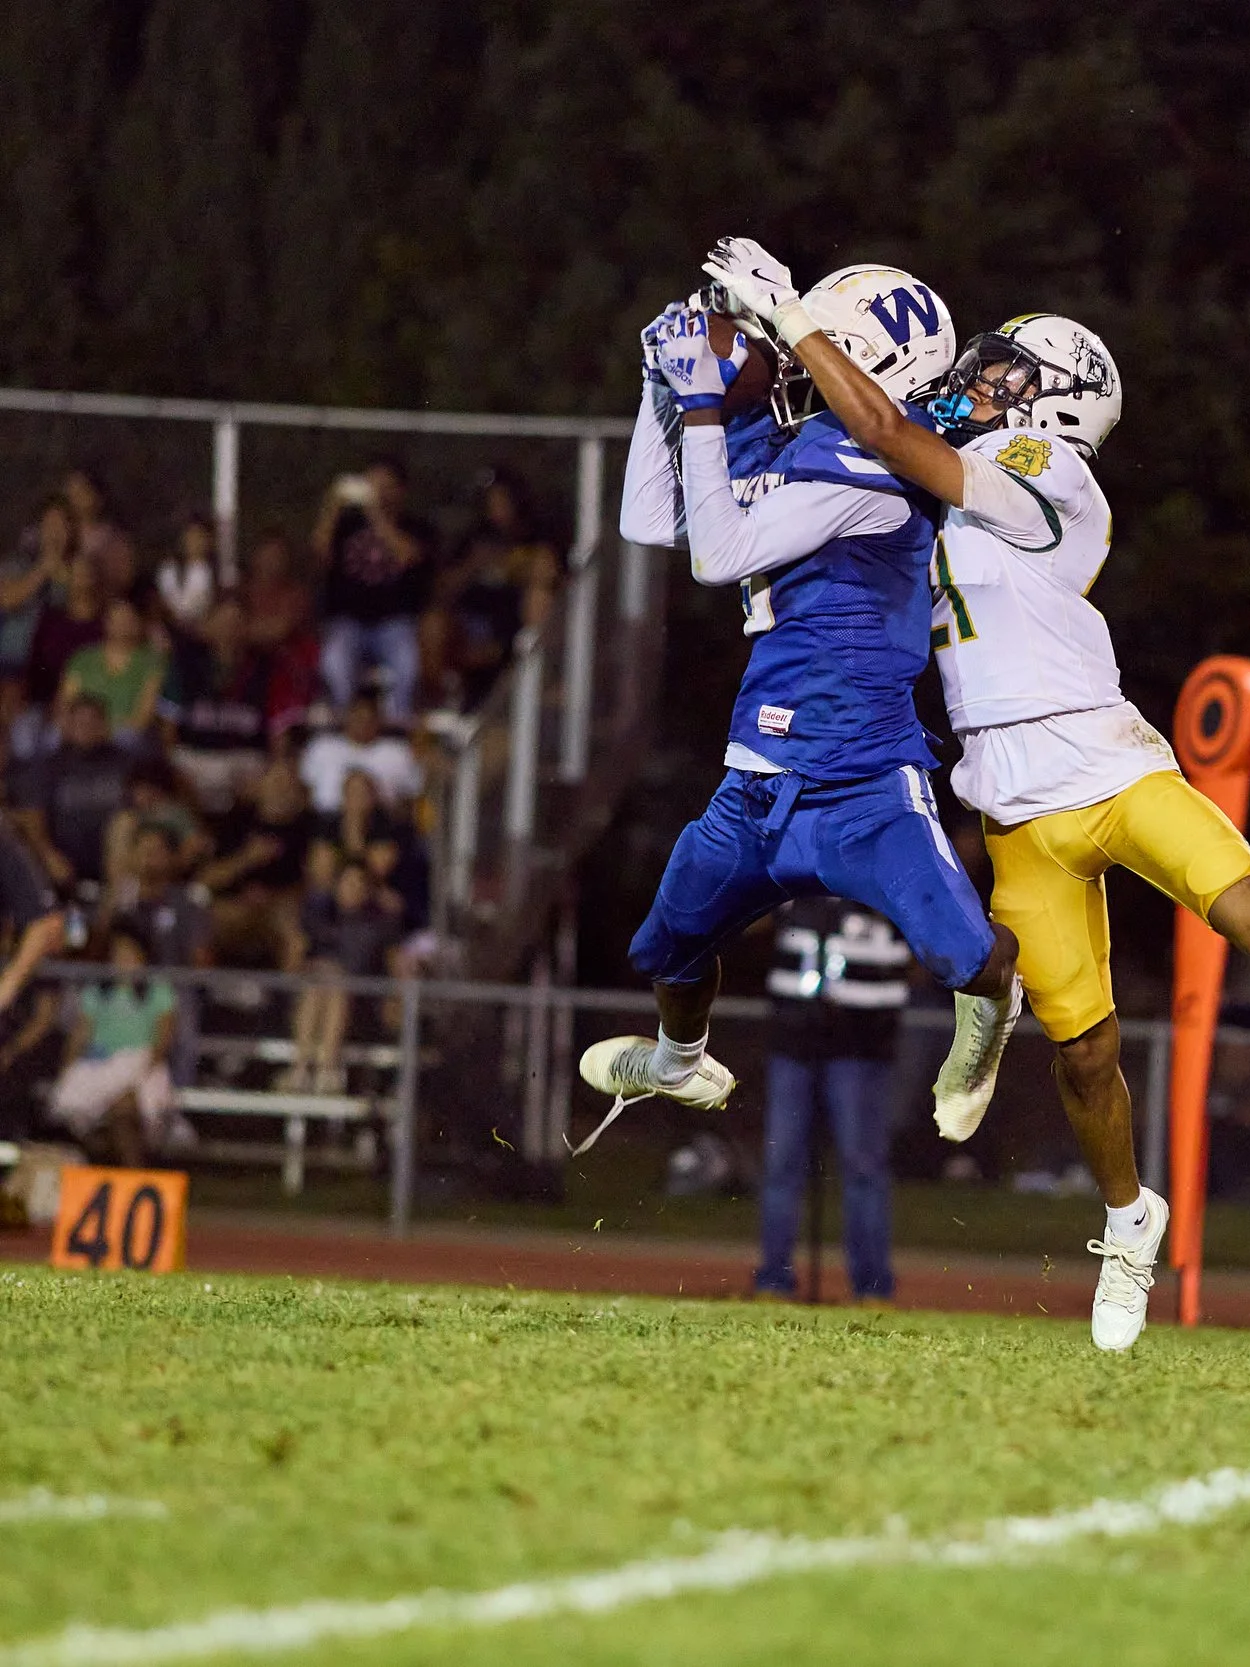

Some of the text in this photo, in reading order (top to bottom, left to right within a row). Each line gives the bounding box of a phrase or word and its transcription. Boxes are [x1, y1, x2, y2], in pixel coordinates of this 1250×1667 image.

[869, 284, 942, 346] W
[662, 361, 694, 386] adidas
[929, 530, 978, 651] 1
[761, 710, 788, 721] Riddell
[68, 1183, 164, 1269] 40
